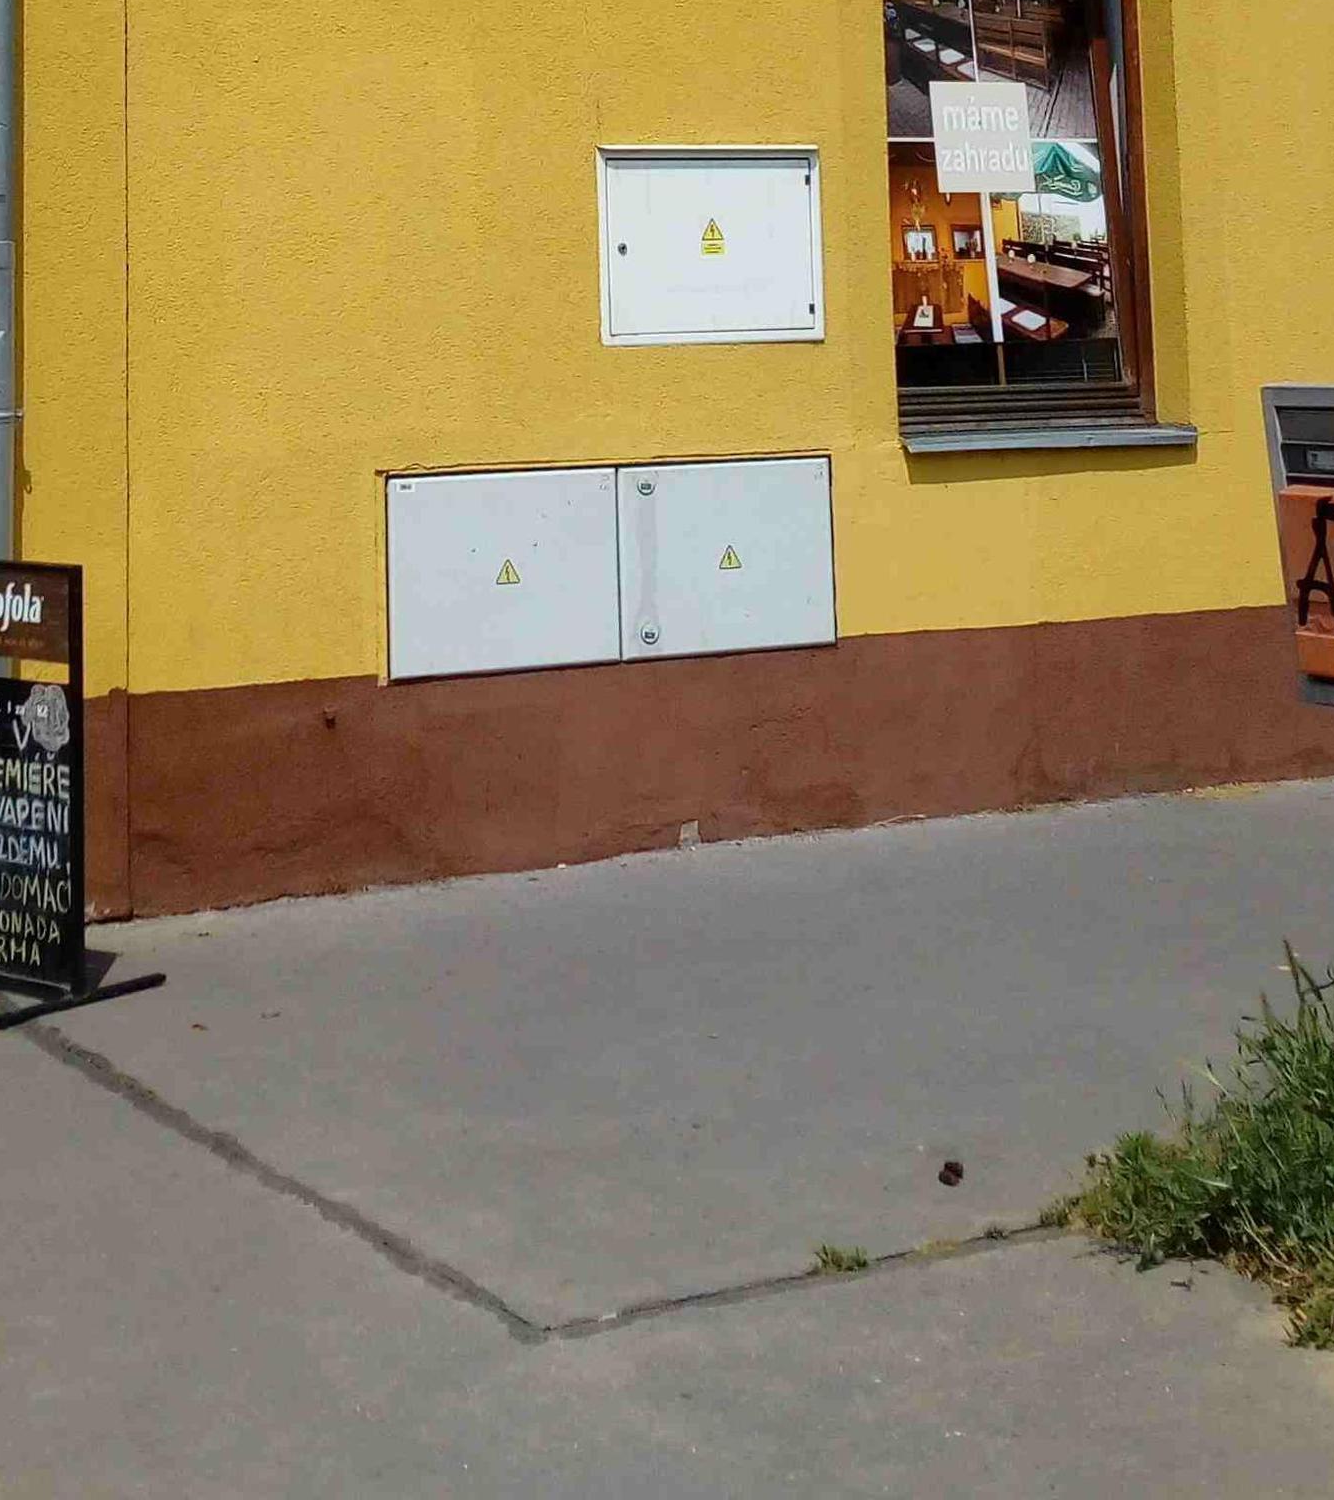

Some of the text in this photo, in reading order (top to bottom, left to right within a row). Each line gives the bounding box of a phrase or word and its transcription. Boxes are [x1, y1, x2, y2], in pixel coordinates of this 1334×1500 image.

[942, 96, 1019, 132] máme
[941, 141, 1028, 174] zahradu
[12, 718, 32, 752] V
